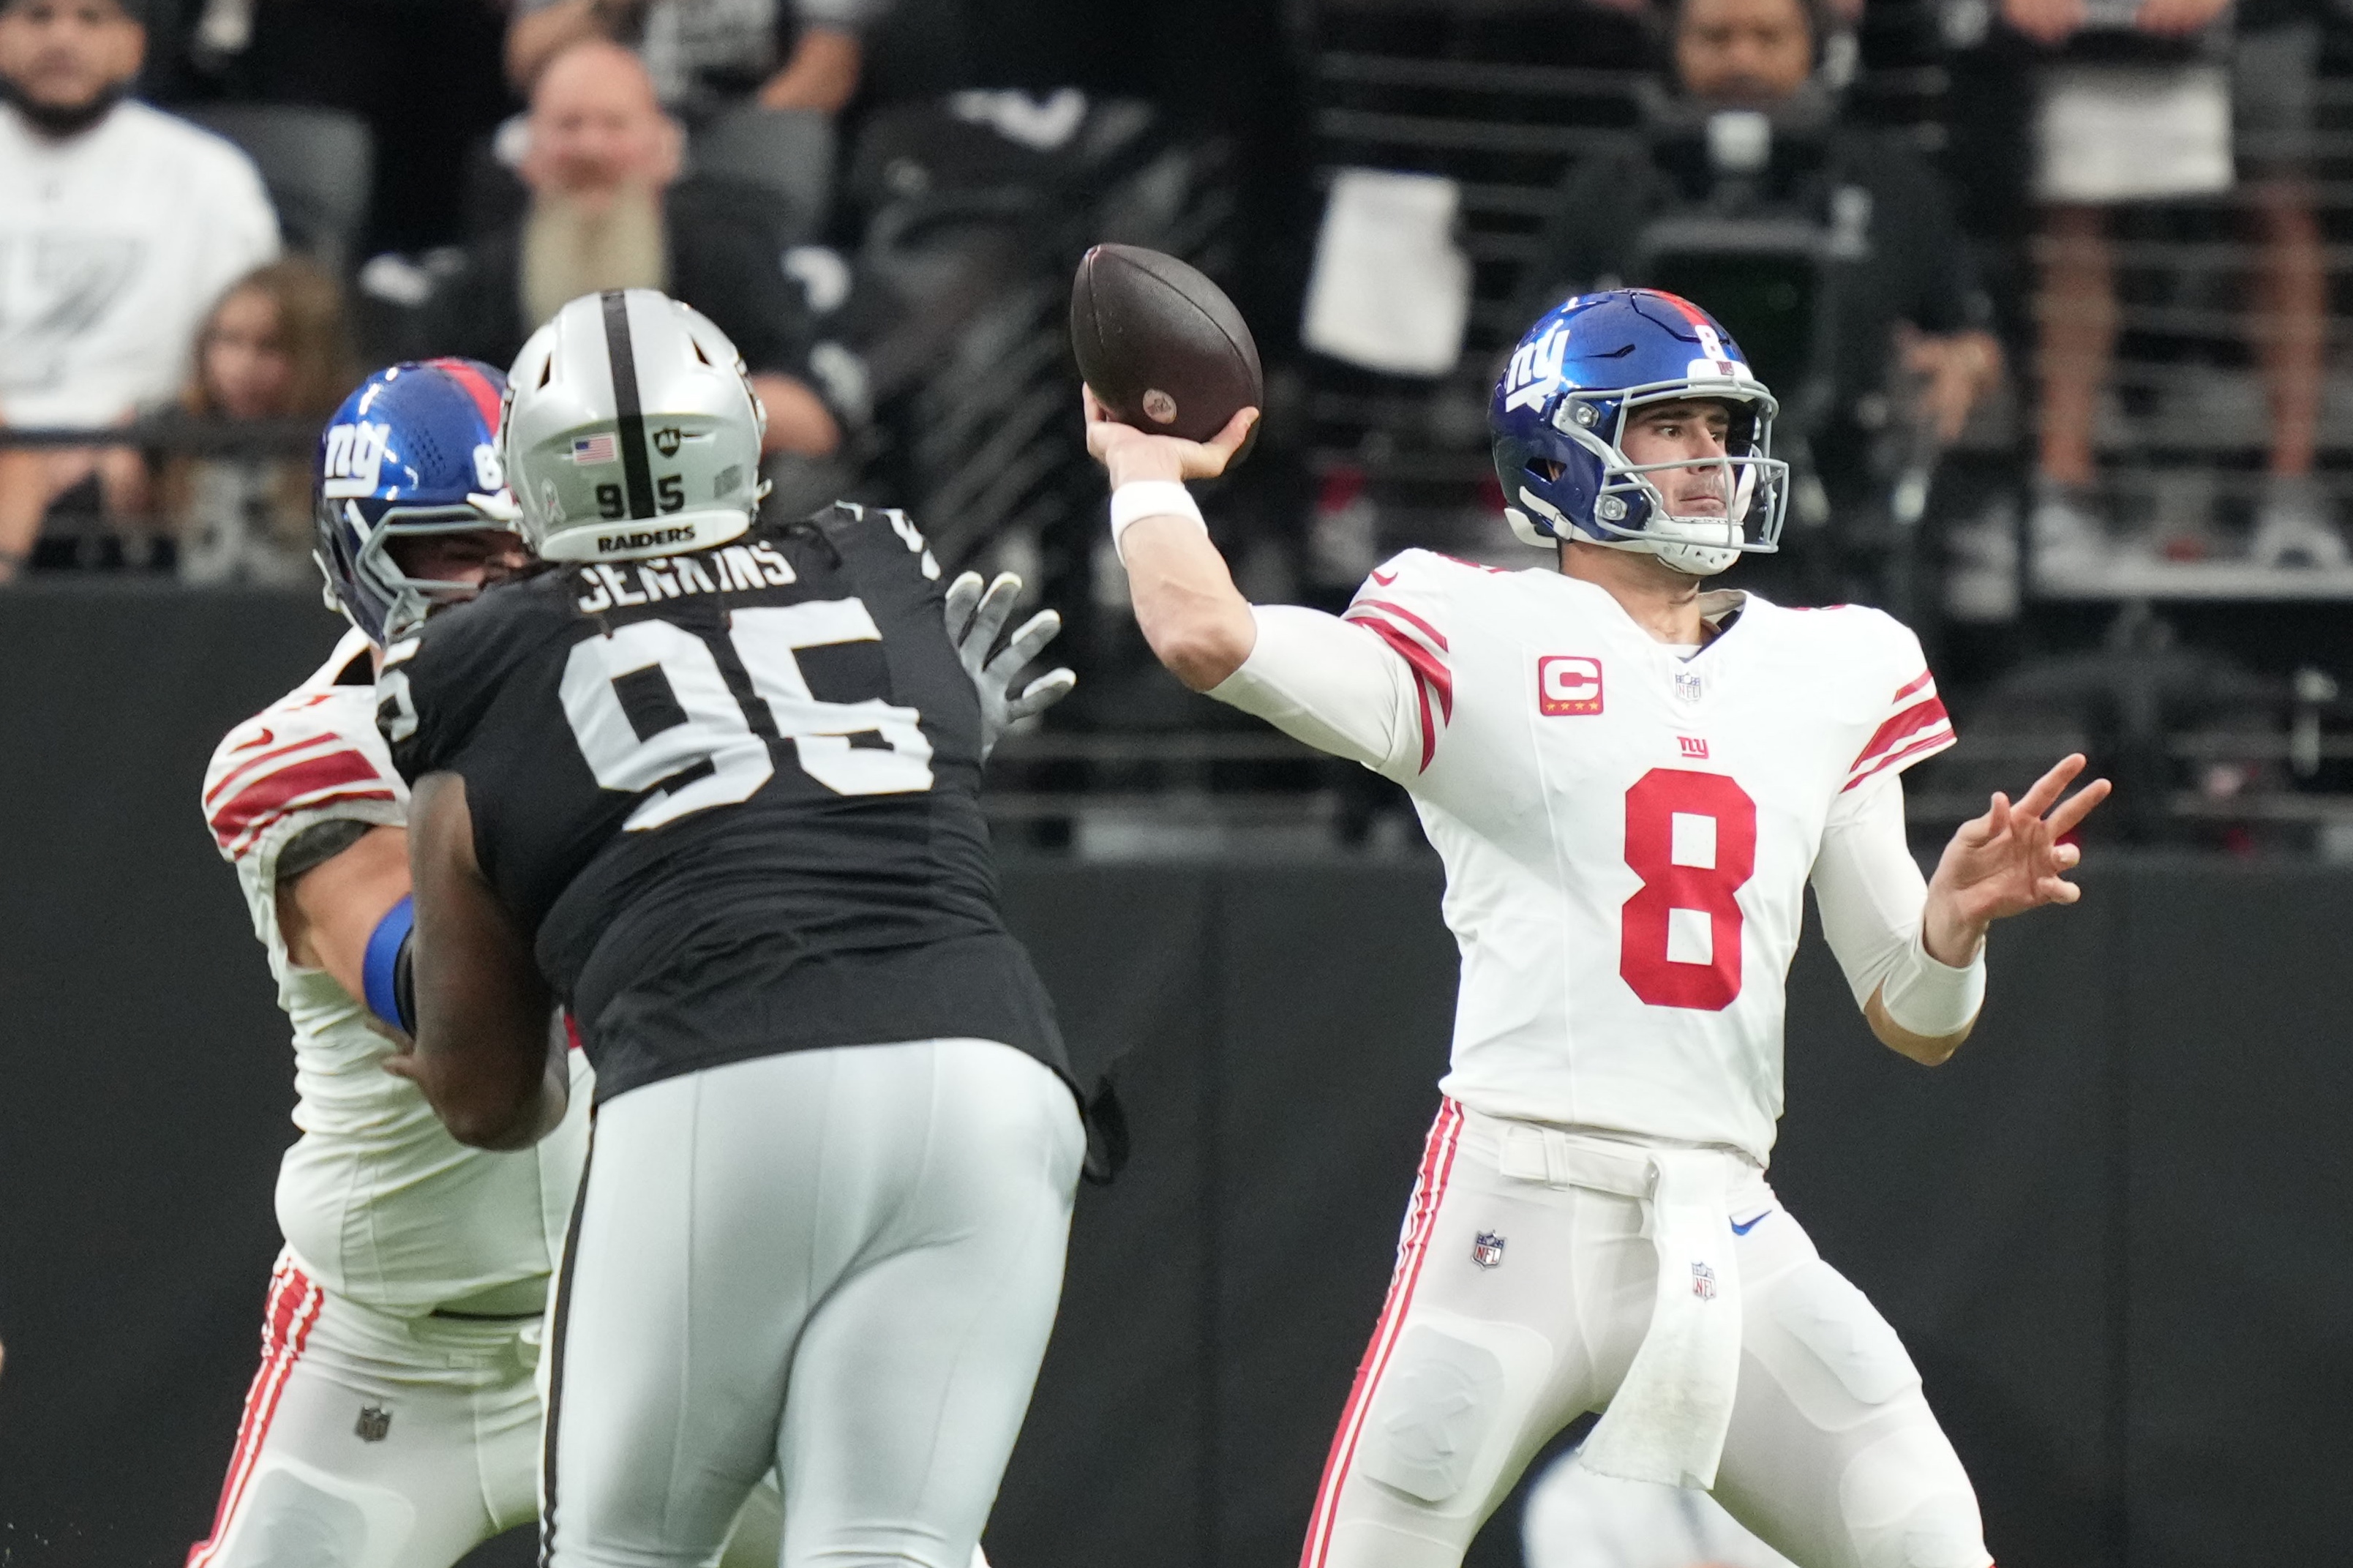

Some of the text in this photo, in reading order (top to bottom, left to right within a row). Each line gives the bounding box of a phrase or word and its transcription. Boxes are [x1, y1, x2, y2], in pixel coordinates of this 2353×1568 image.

[1695, 325, 1727, 360] 8
[598, 525, 695, 552] RAIDERS
[578, 540, 798, 613] JENKINS
[1544, 659, 1599, 701] C
[559, 597, 934, 831] 95
[1619, 768, 1757, 1012] 8
